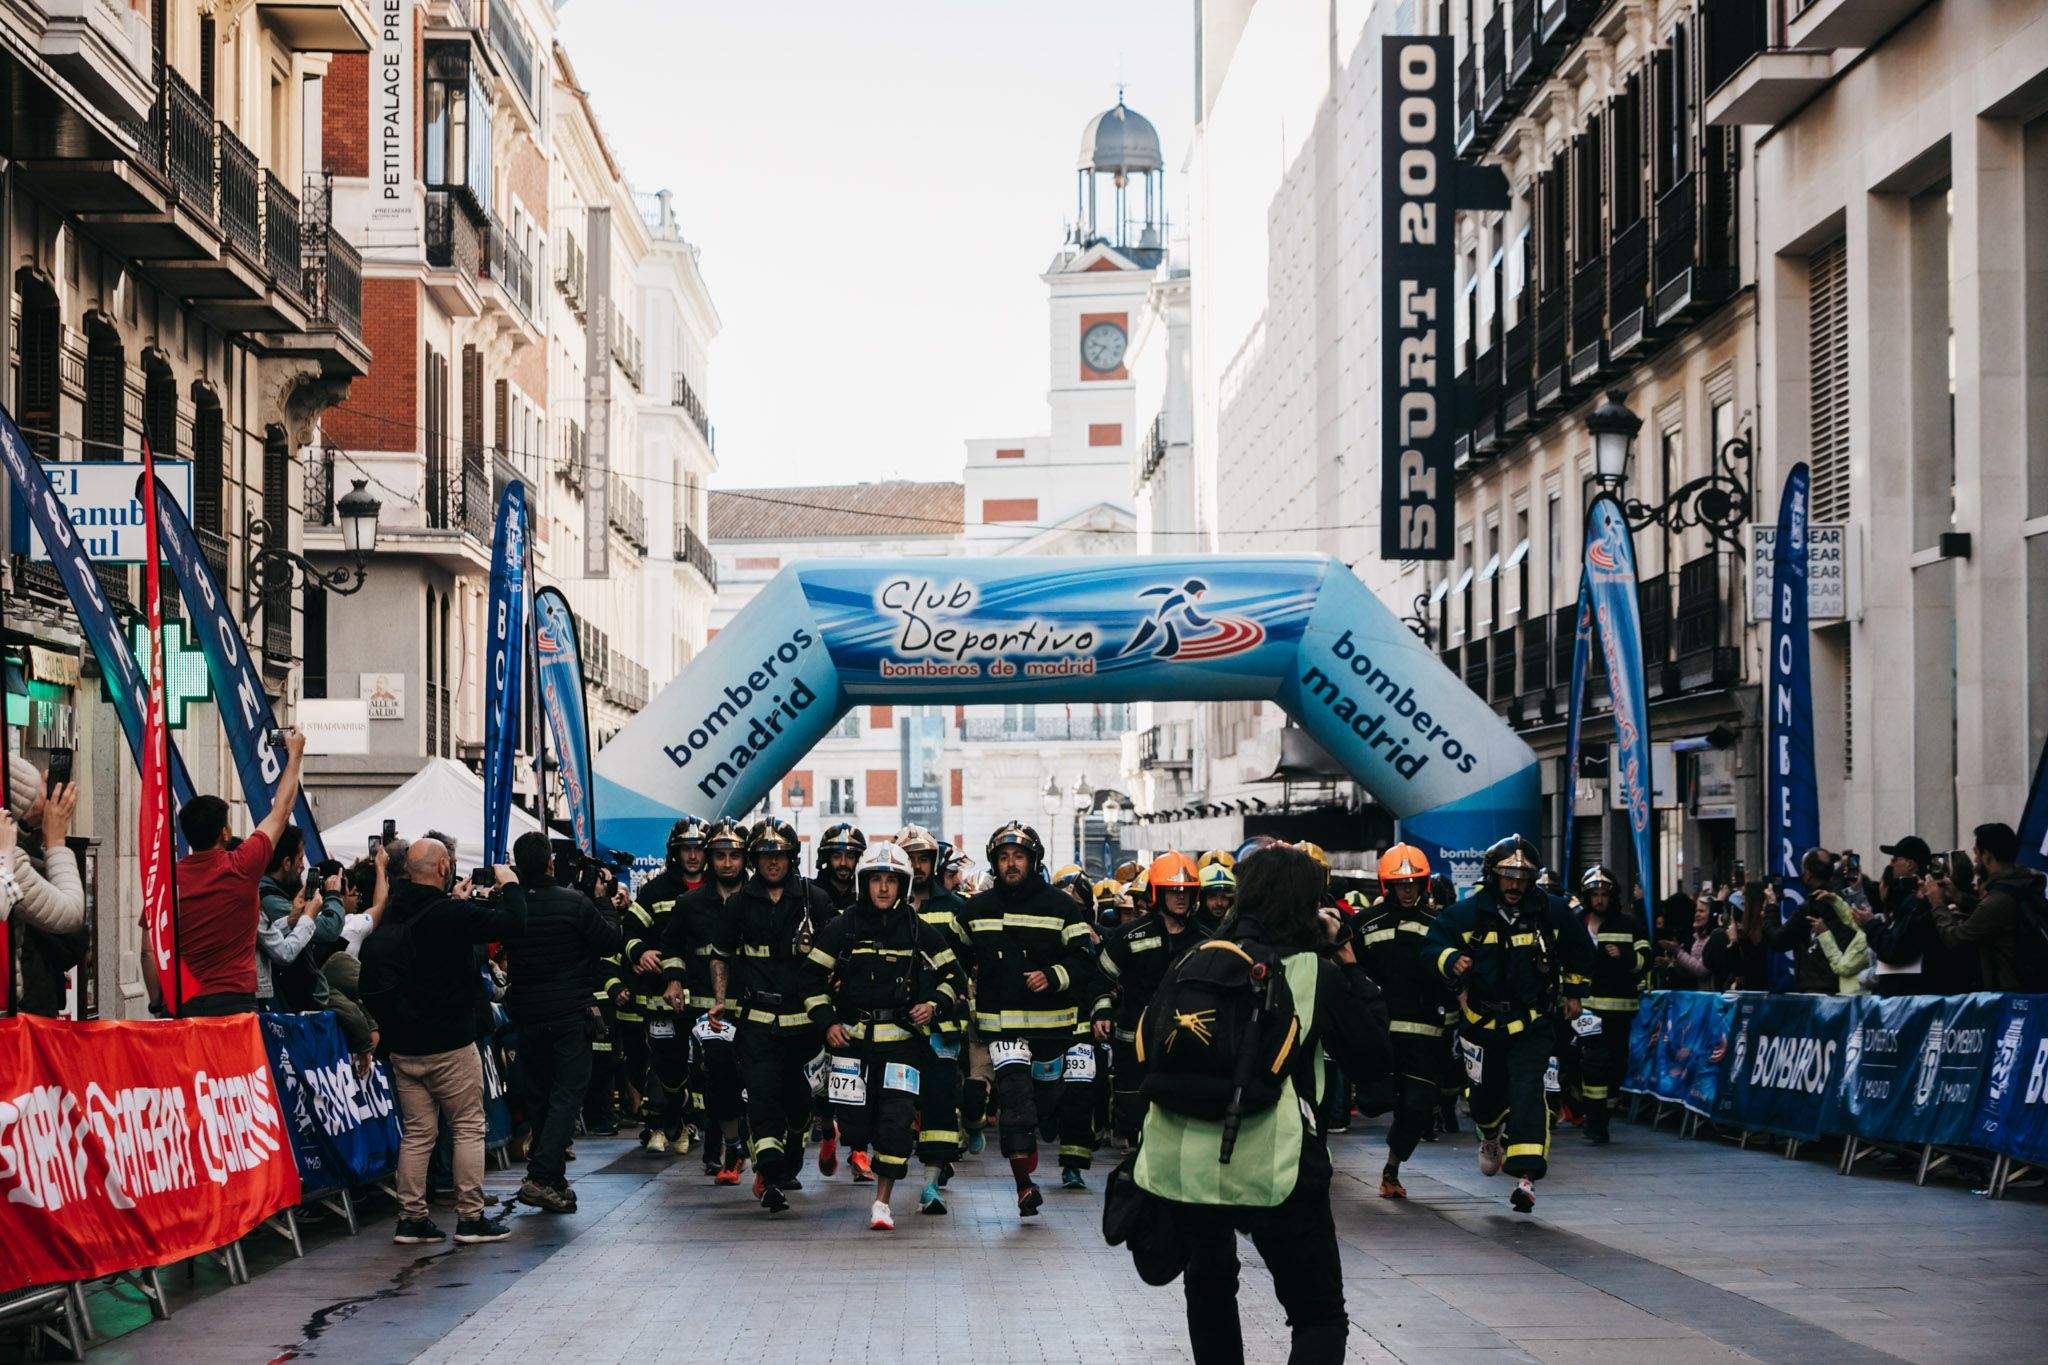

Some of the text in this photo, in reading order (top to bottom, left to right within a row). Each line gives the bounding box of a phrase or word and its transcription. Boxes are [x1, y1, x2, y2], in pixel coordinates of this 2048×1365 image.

[1400, 44, 1437, 549] SPORT 2000
[882, 580, 972, 612] Club
[900, 610, 1094, 659] Deportivo
[663, 627, 813, 768] bomberos
[881, 659, 1097, 677] bomberos de madrid
[1331, 629, 1478, 774] bomberos
[306, 722, 366, 731] STRADIVARIUS
[697, 676, 818, 800] madrid
[1301, 666, 1430, 781] madrid
[1440, 846, 1486, 859] bombe
